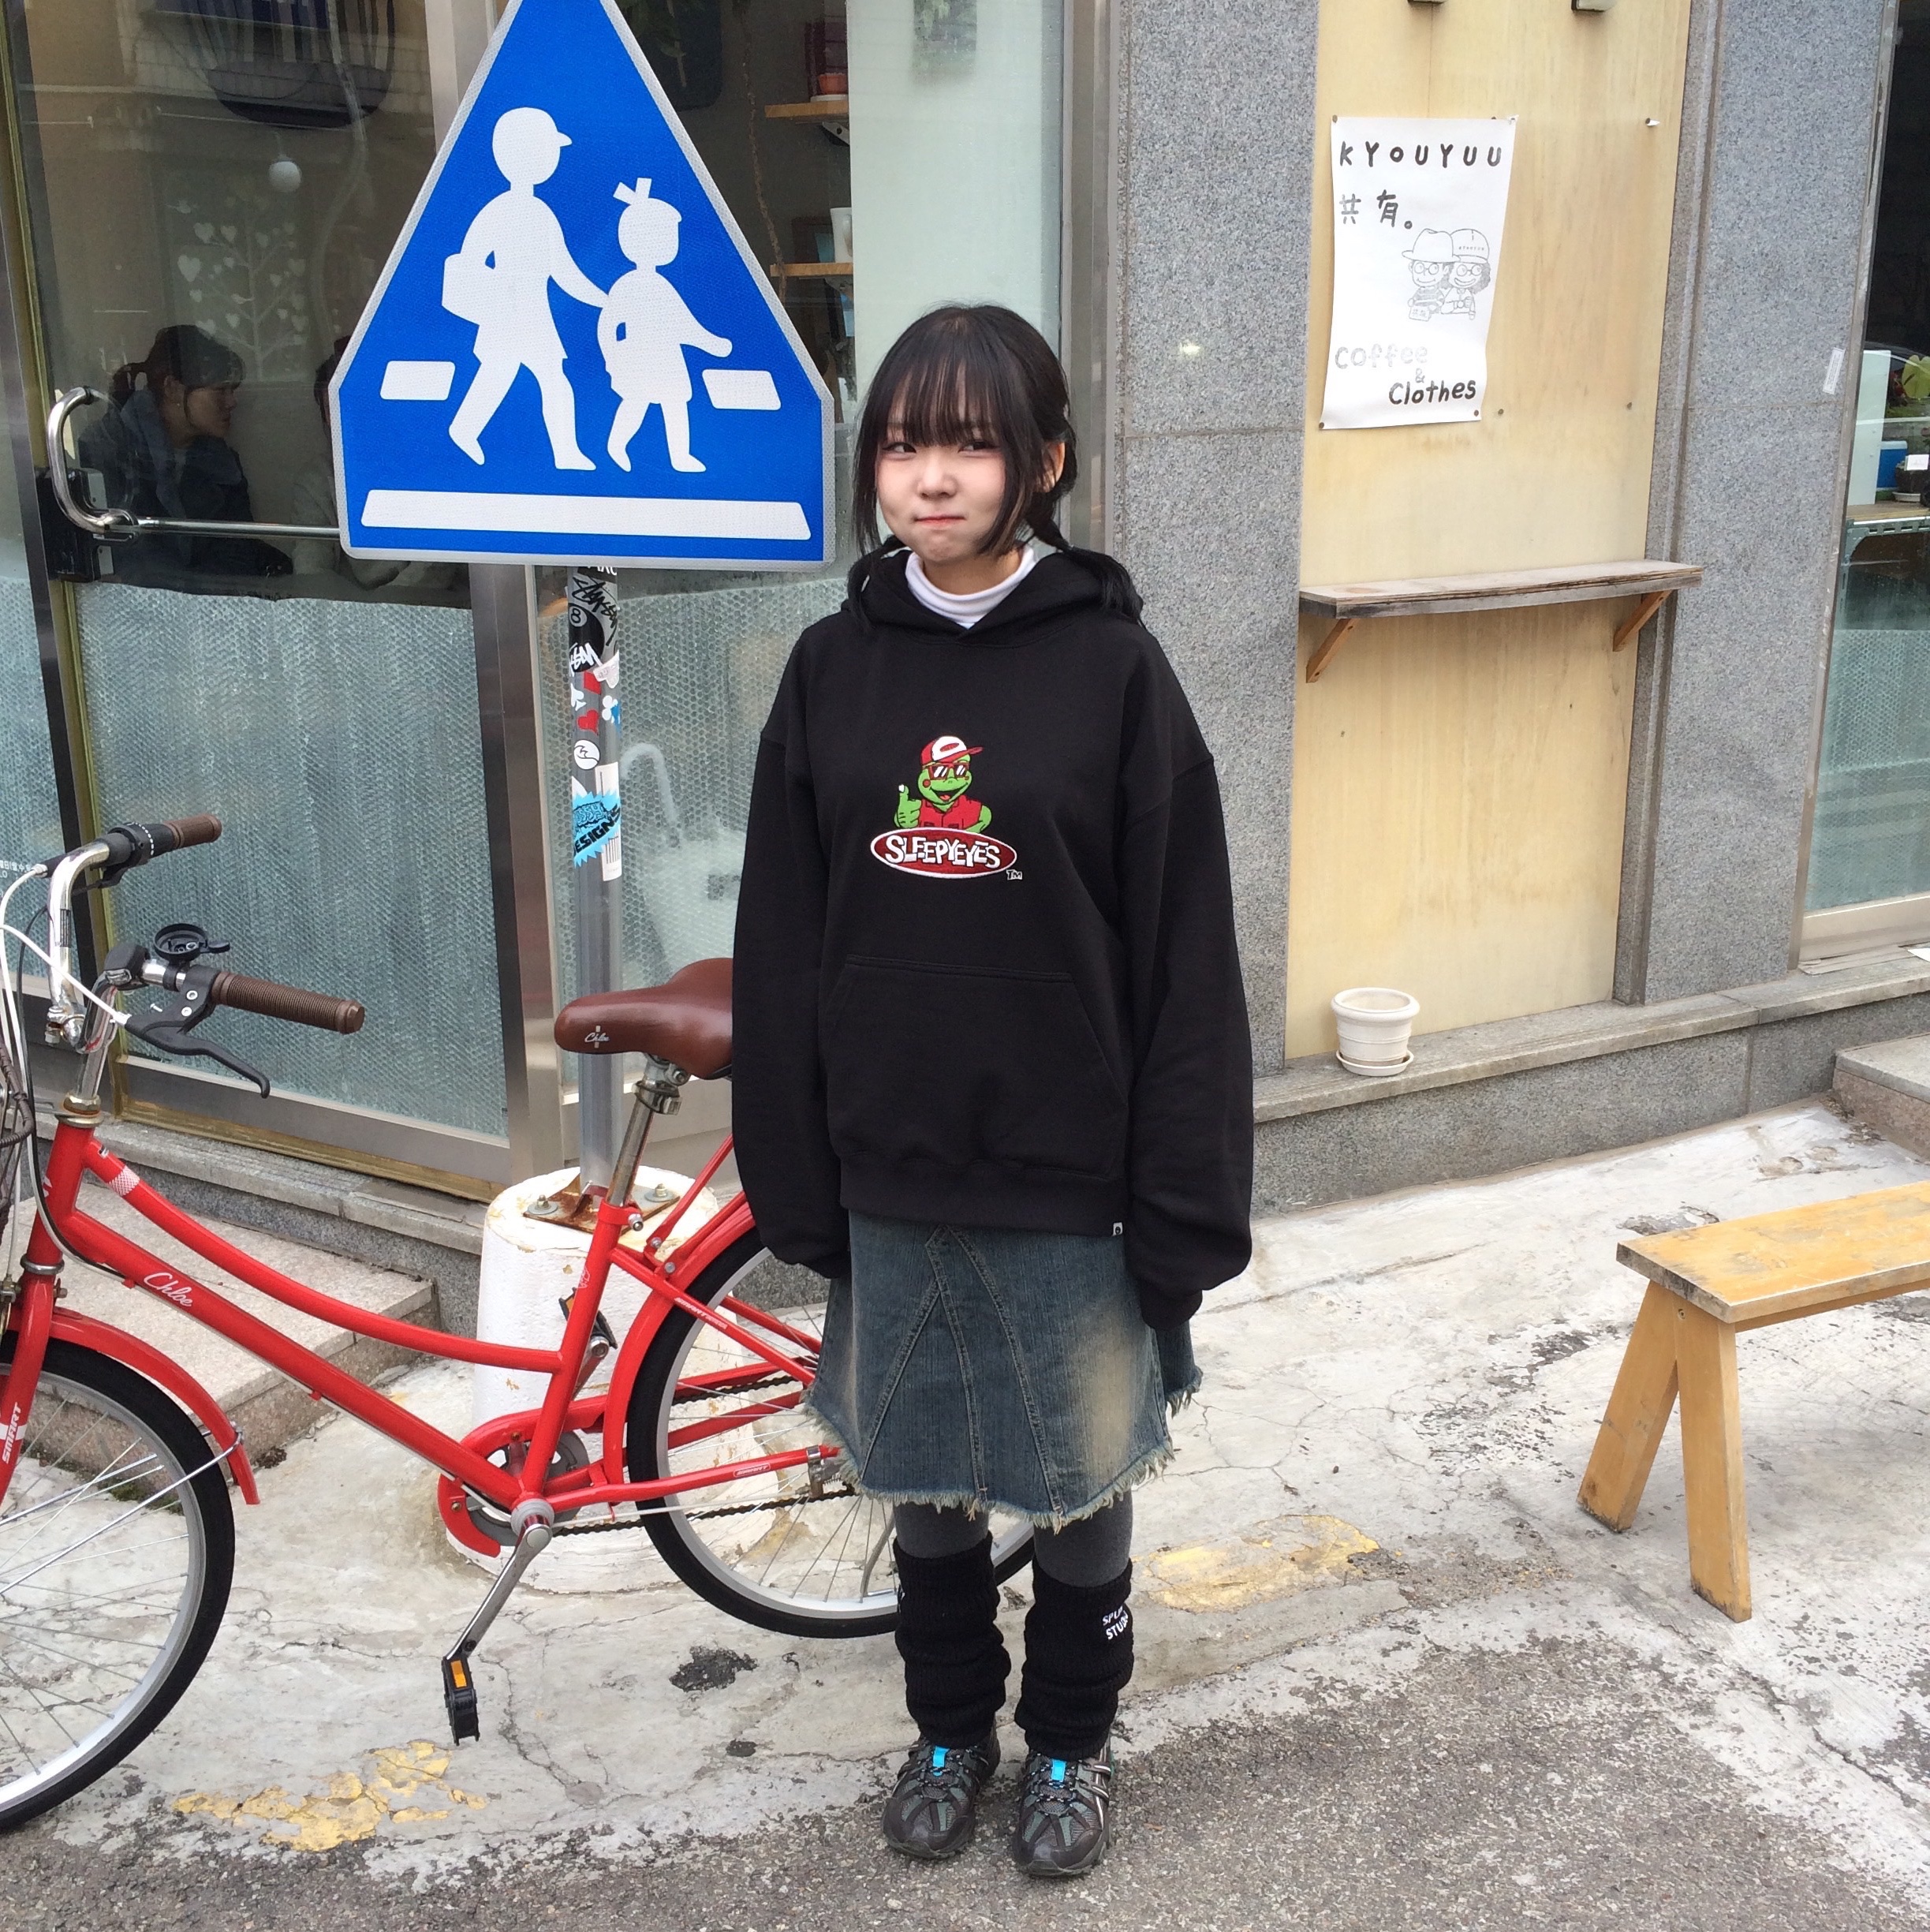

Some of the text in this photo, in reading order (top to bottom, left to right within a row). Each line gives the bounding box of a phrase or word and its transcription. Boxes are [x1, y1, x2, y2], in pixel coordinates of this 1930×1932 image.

[1388, 379, 1476, 405] Clothes
[885, 835, 1000, 869] SLEEPYEYES
[144, 1272, 193, 1307] Chloe
[2, 1401, 21, 1464] SMART
